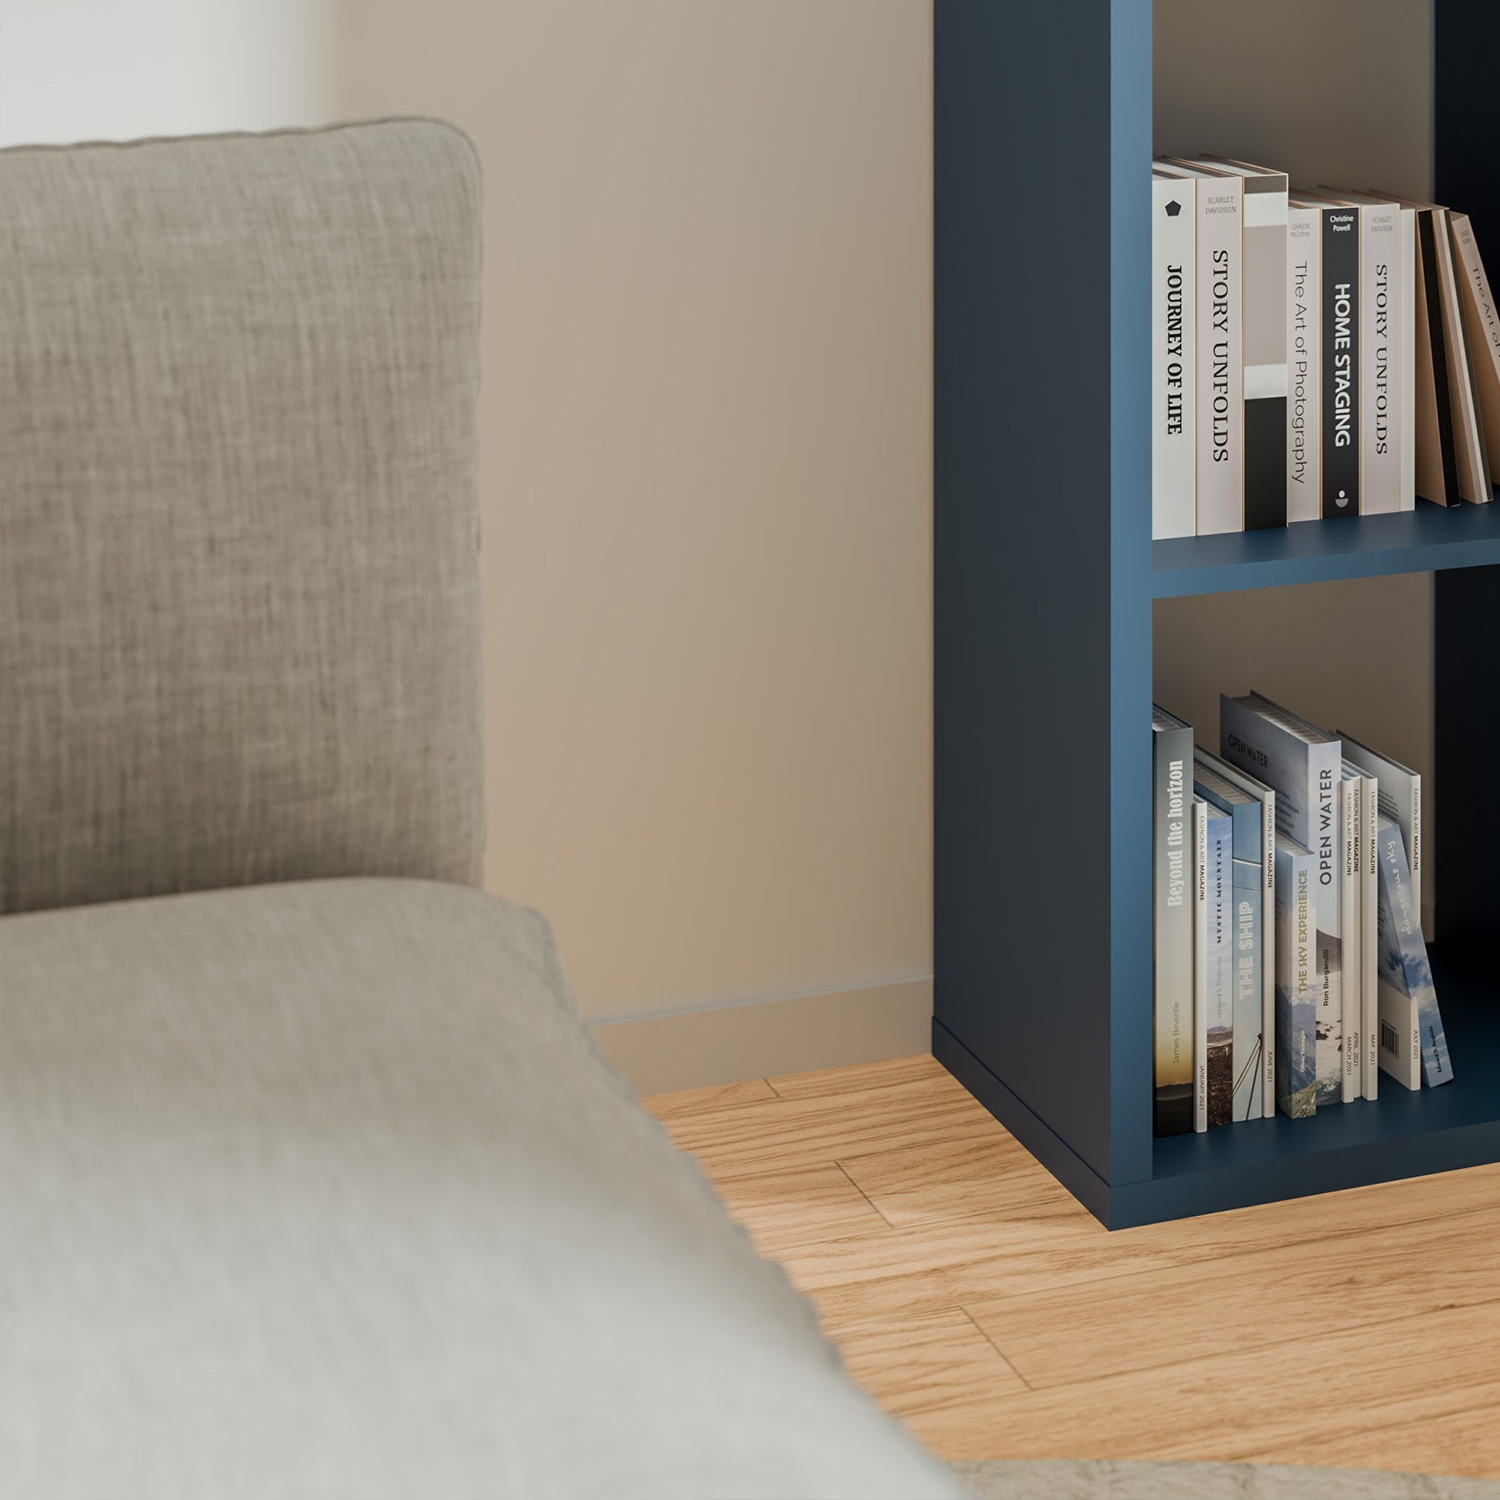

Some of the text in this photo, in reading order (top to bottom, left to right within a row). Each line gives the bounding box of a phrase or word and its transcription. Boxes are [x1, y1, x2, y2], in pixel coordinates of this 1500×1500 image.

[1205, 206, 1237, 215] DAVIDSON
[1207, 196, 1234, 204] SCARLET
[1330, 215, 1354, 223] Christine
[1333, 224, 1351, 232] Powell
[1473, 264, 1485, 298] The
[1483, 303, 1494, 328] Art
[1167, 265, 1182, 435] JOURNEY OF LIFE
[1213, 250, 1229, 462] STORY UNFOLDS
[1292, 260, 1308, 484] The Art of Photography
[1335, 283, 1351, 447] HOME STAGING
[1376, 264, 1388, 454] STORY UNFOLDS
[1247, 744, 1268, 769] WATER
[1167, 760, 1185, 908] Beyond the horizon
[1320, 769, 1332, 885] OPEN WATER
[1386, 841, 1397, 864] sky
[1239, 901, 1254, 1000] THE SHIP
[1298, 870, 1307, 994] THE SKY EXPERIENCE
